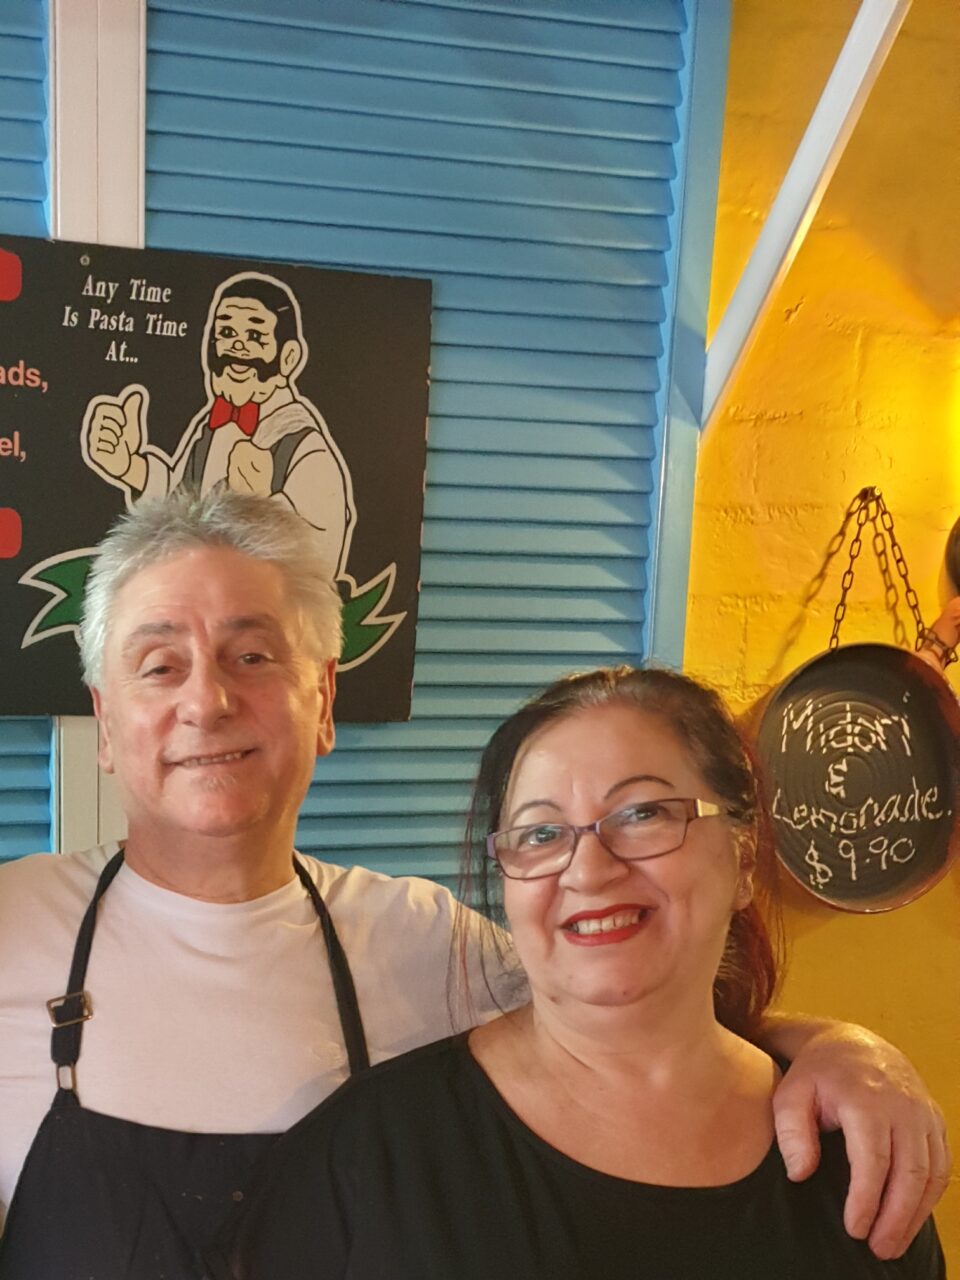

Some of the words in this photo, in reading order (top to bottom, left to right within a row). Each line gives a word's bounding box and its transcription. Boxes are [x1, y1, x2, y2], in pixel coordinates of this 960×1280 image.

[81, 274, 120, 305] Any
[130, 278, 172, 304] Time
[62, 306, 79, 328] Is
[88, 309, 135, 333] Pasta
[146, 313, 188, 338] Time
[105, 341, 139, 364] At...
